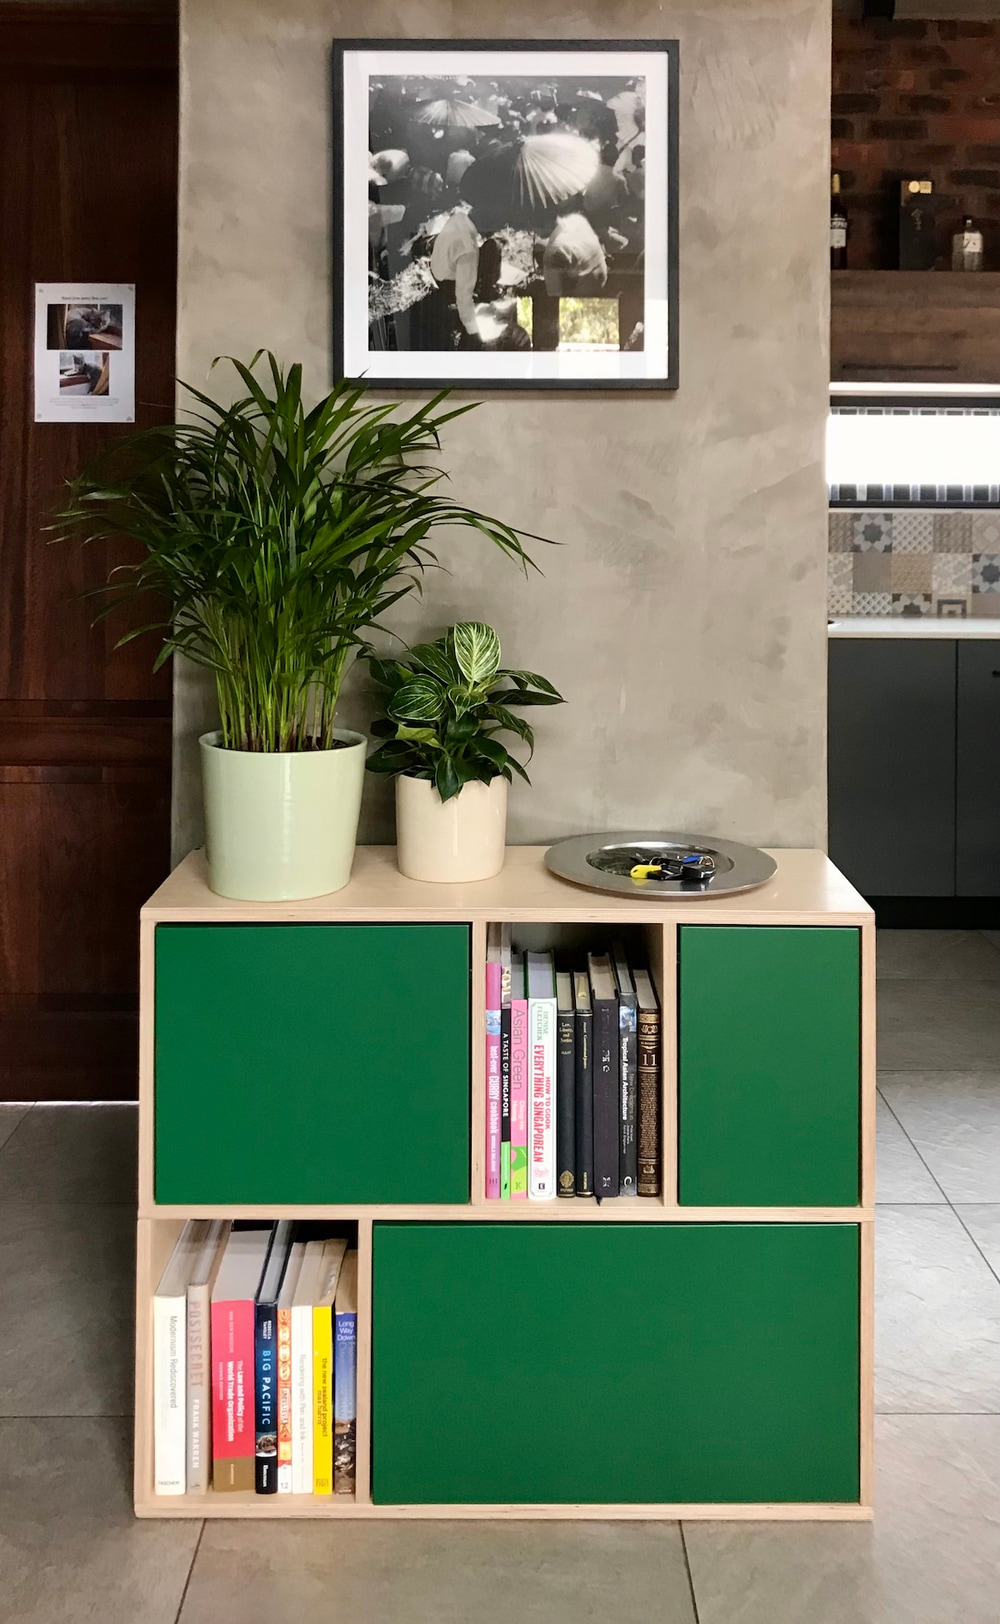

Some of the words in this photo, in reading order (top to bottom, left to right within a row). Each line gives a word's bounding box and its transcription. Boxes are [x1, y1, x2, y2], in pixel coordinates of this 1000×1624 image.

[513, 1009, 525, 1044] Asian
[503, 1063, 508, 1072] OF
[513, 1049, 525, 1089] Green
[533, 1045, 544, 1098] EVERYTHING
[643, 1054, 657, 1066] 11
[489, 1076, 499, 1100] CURRY
[545, 1097, 551, 1106] TO
[490, 1102, 498, 1133] cookbook
[533, 1102, 544, 1162] SINGAPOREAN
[170, 1316, 178, 1356] Modernism
[189, 1301, 203, 1387] POSTSECRET
[262, 1350, 271, 1371] BIG
[170, 1359, 178, 1408] Rediscovered
[262, 1378, 271, 1425] PACIFIC
[192, 1399, 200, 1428] FRANK
[192, 1431, 200, 1468] WARREN
